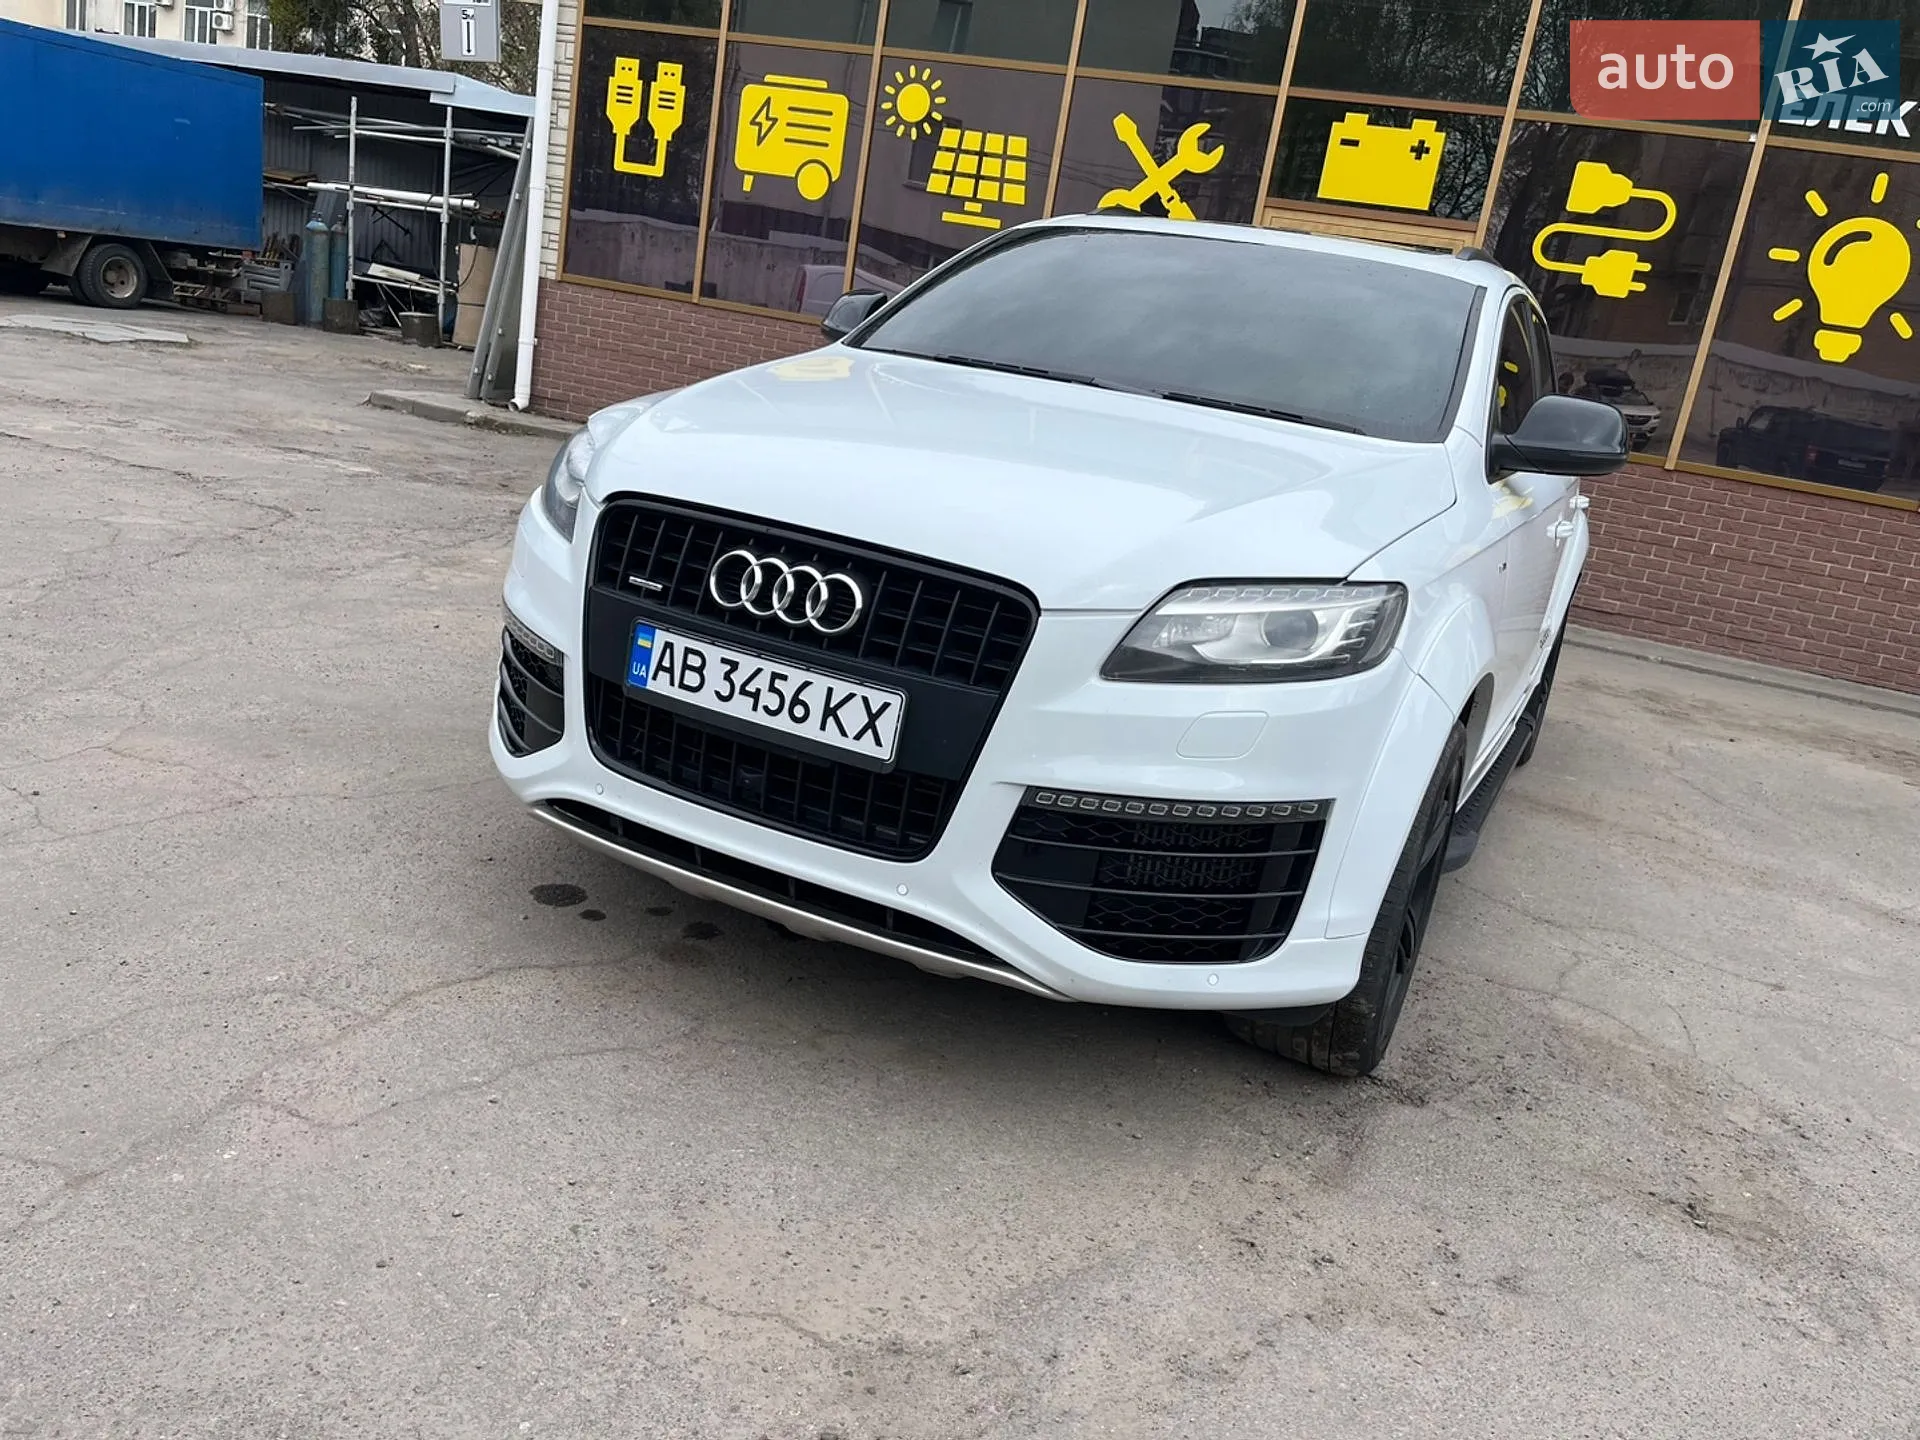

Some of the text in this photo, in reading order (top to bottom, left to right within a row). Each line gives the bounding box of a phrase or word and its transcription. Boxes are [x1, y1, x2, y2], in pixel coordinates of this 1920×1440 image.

[1778, 91, 1920, 138] ЕЛЕК
[632, 661, 647, 678] UA
[651, 640, 892, 748] AB 3456 KX
